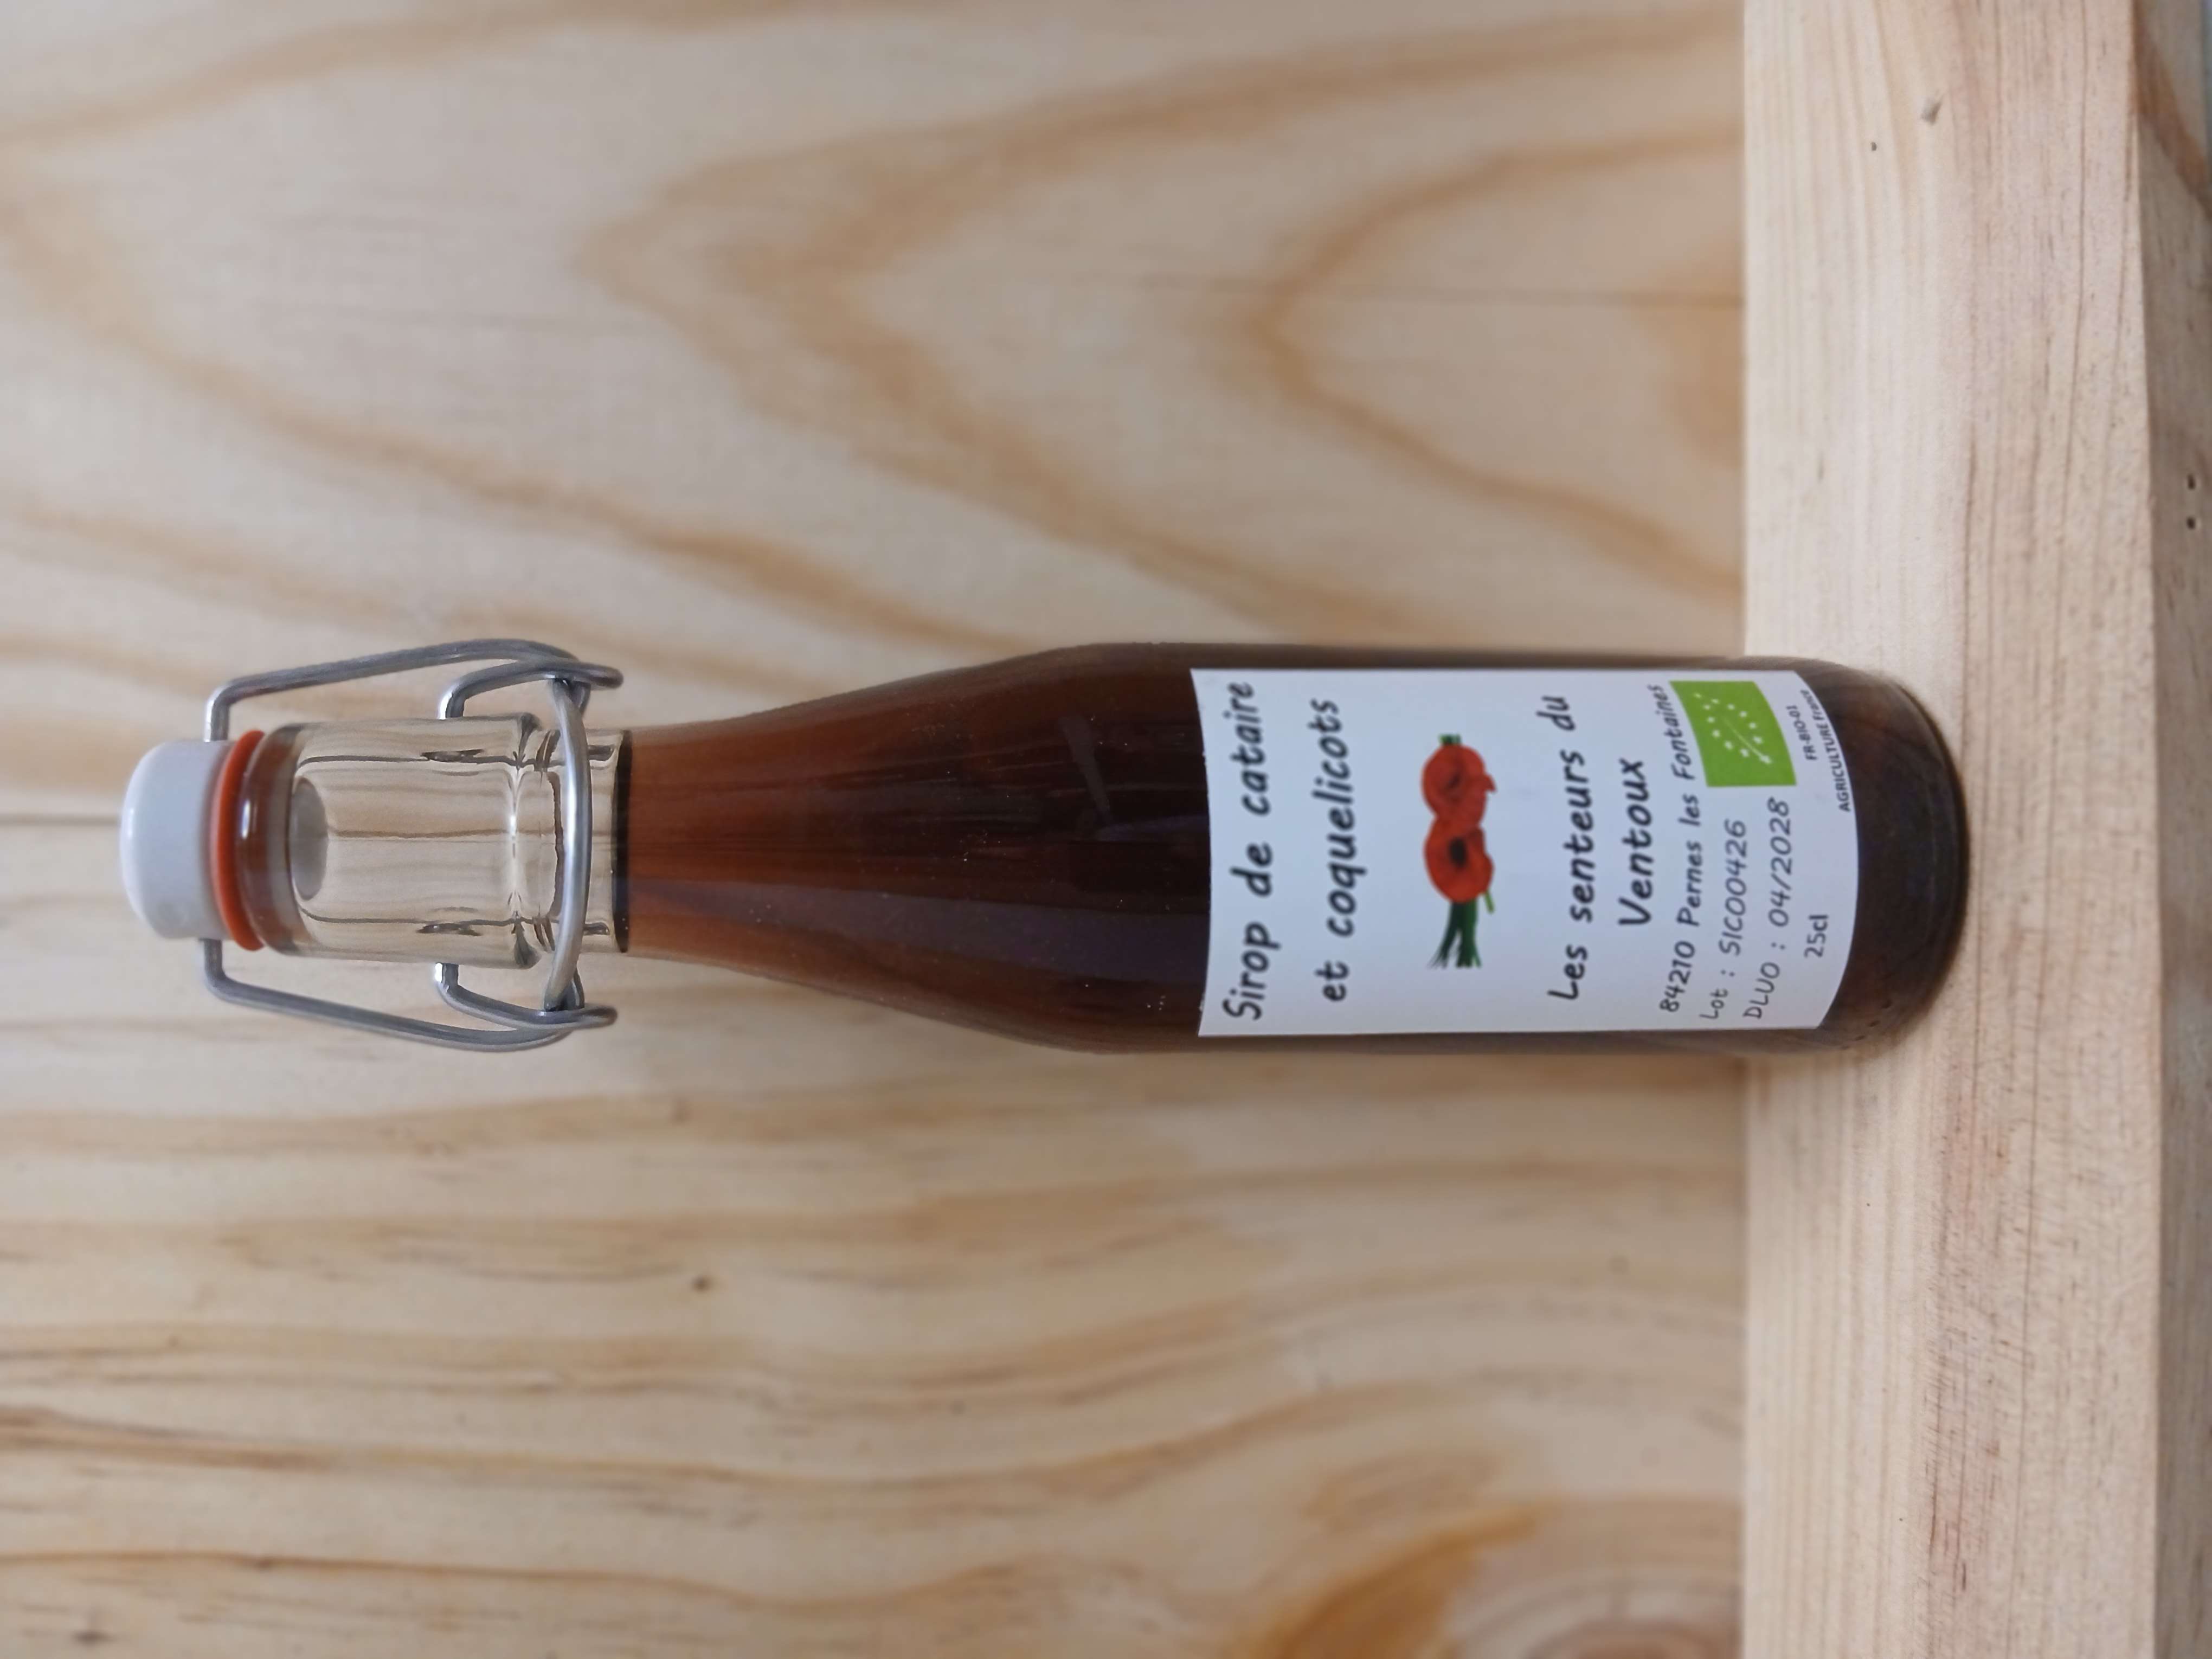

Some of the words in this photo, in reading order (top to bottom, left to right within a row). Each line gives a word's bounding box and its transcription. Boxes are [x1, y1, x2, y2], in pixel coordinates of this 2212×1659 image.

[1536, 696, 1576, 731] du
[1648, 686, 1695, 780] Fontaines
[1786, 705, 1817, 760] FR-BIO-01
[1800, 689, 1825, 722] France
[1223, 683, 1271, 816] cataire
[1817, 724, 1850, 812] AGRICULTURE
[1308, 699, 1367, 937] coquelicots
[1560, 750, 1595, 923] senteurs
[1618, 758, 1654, 925] Ventoux
[1678, 794, 1700, 826] les
[1230, 843, 1272, 897] de
[1676, 841, 1702, 927] Pernes
[1743, 962, 1779, 1019] DLUO
[1767, 797, 1792, 927] 04/2028
[1804, 914, 1828, 957] 25cl
[1222, 922, 1281, 1020] Sirop
[1315, 961, 1349, 1002] et
[1547, 944, 1587, 1000] Les
[1660, 941, 1695, 1012] 84210
[1700, 990, 1728, 1019] Lot
